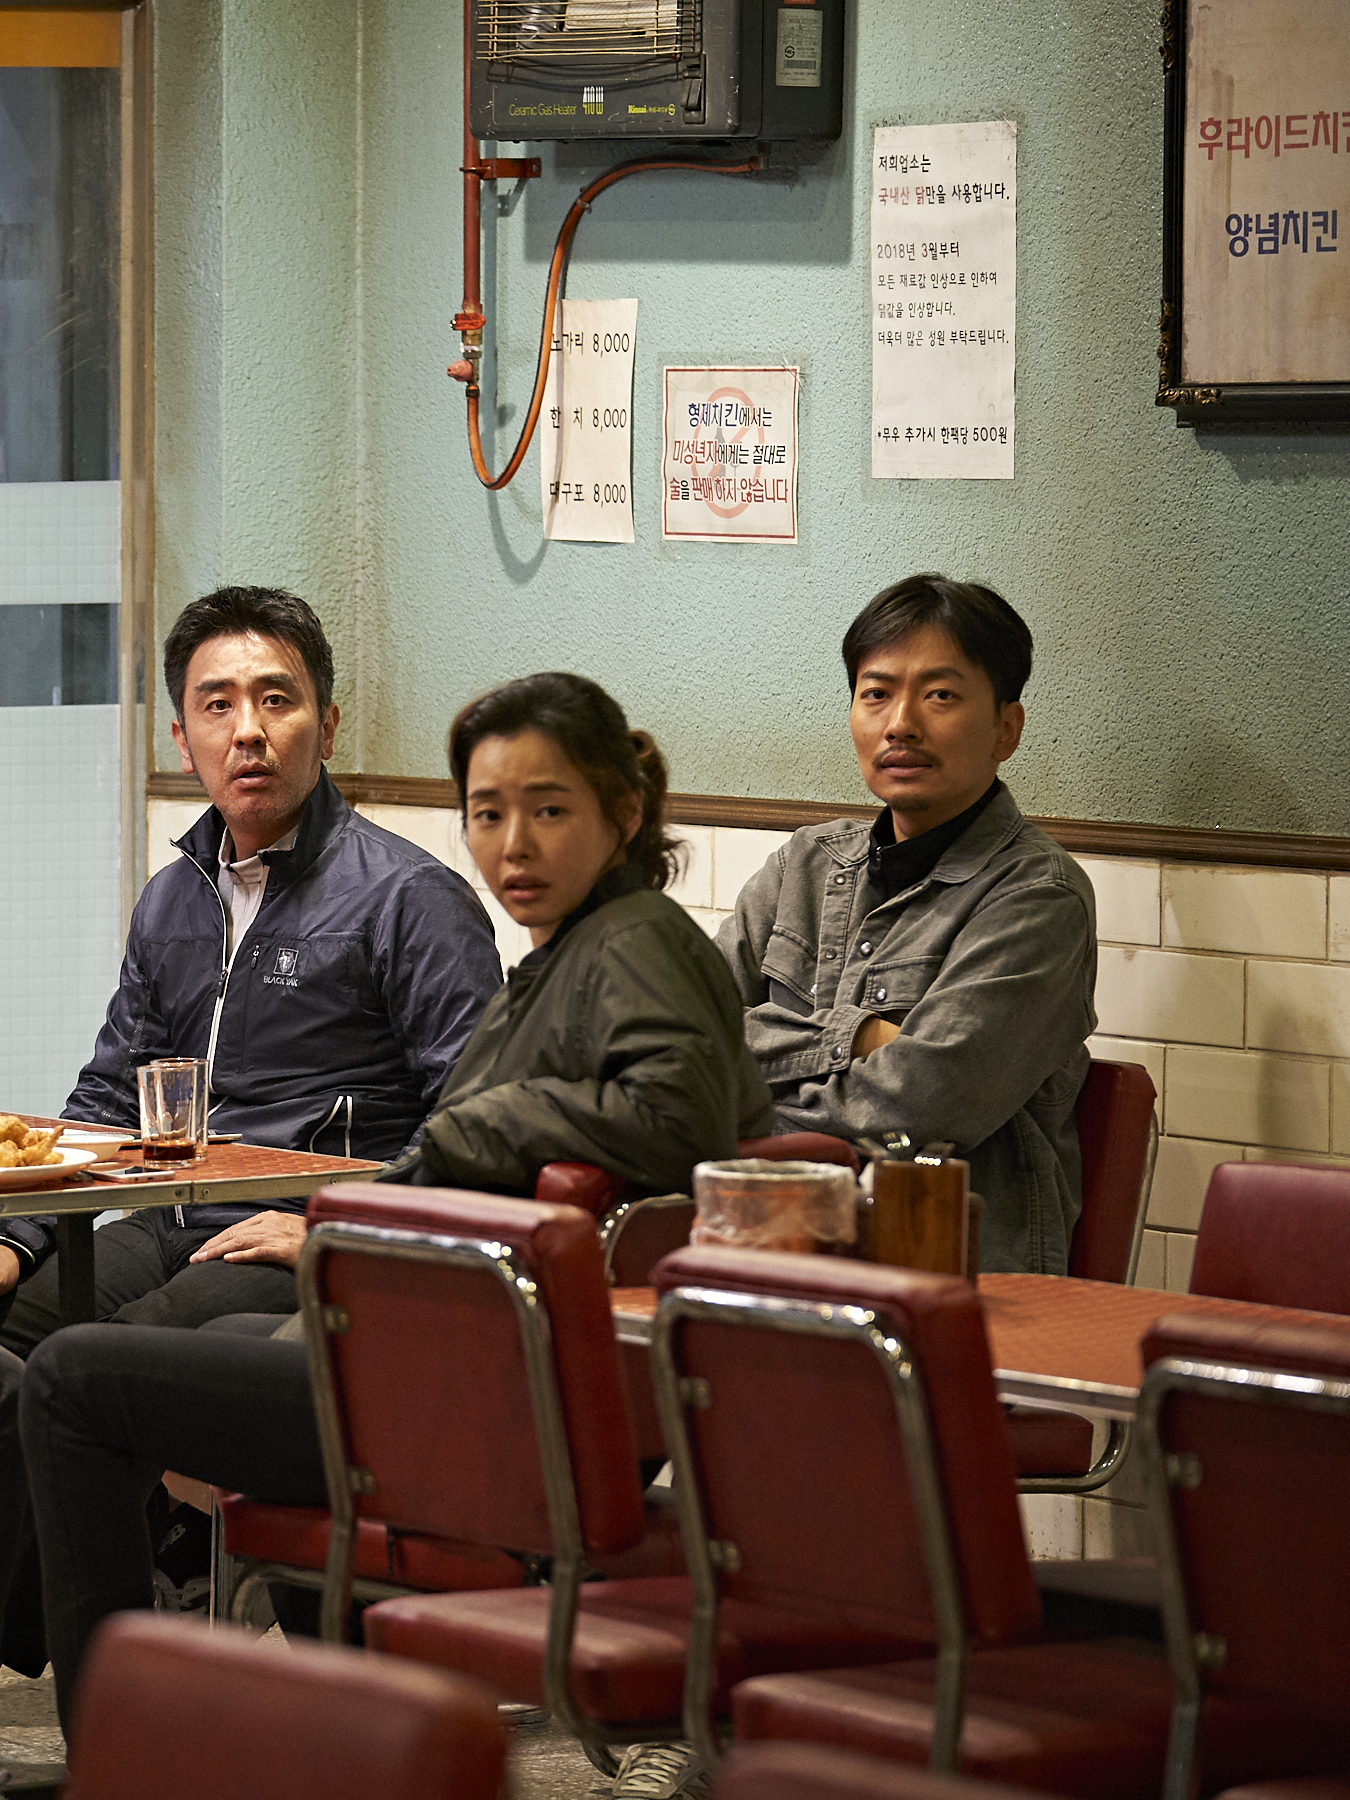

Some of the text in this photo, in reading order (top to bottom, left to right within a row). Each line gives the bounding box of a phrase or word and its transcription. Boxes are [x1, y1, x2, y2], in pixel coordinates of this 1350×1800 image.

[509, 103, 577, 116] Ceramic Gas Heater
[628, 105, 647, 114] Rinnai
[879, 154, 931, 173] 저희업소는
[879, 182, 1009, 206] 국내산 닭만을 사용합니다.
[1225, 210, 1338, 258] 양념치킨
[877, 241, 960, 261] 2018년 3월부터
[878, 271, 997, 290] 모든 재료값 인상으로 인하여
[878, 301, 955, 318] 닭값을 인상합니다.
[550, 331, 630, 358] 노가리 8,000
[878, 329, 1009, 347] 더욱더 많은 성원 부탁드립니다.
[592, 408, 627, 433] 8,000
[688, 402, 772, 427] 형제치킨에서는
[905, 426, 936, 442] 추가시
[972, 426, 1008, 444] 500원
[672, 440, 786, 465] 미성년자에게는 절대로
[550, 480, 627, 508] 대구포 8,000
[669, 477, 690, 501] 술을
[740, 478, 788, 503] 않습니다
